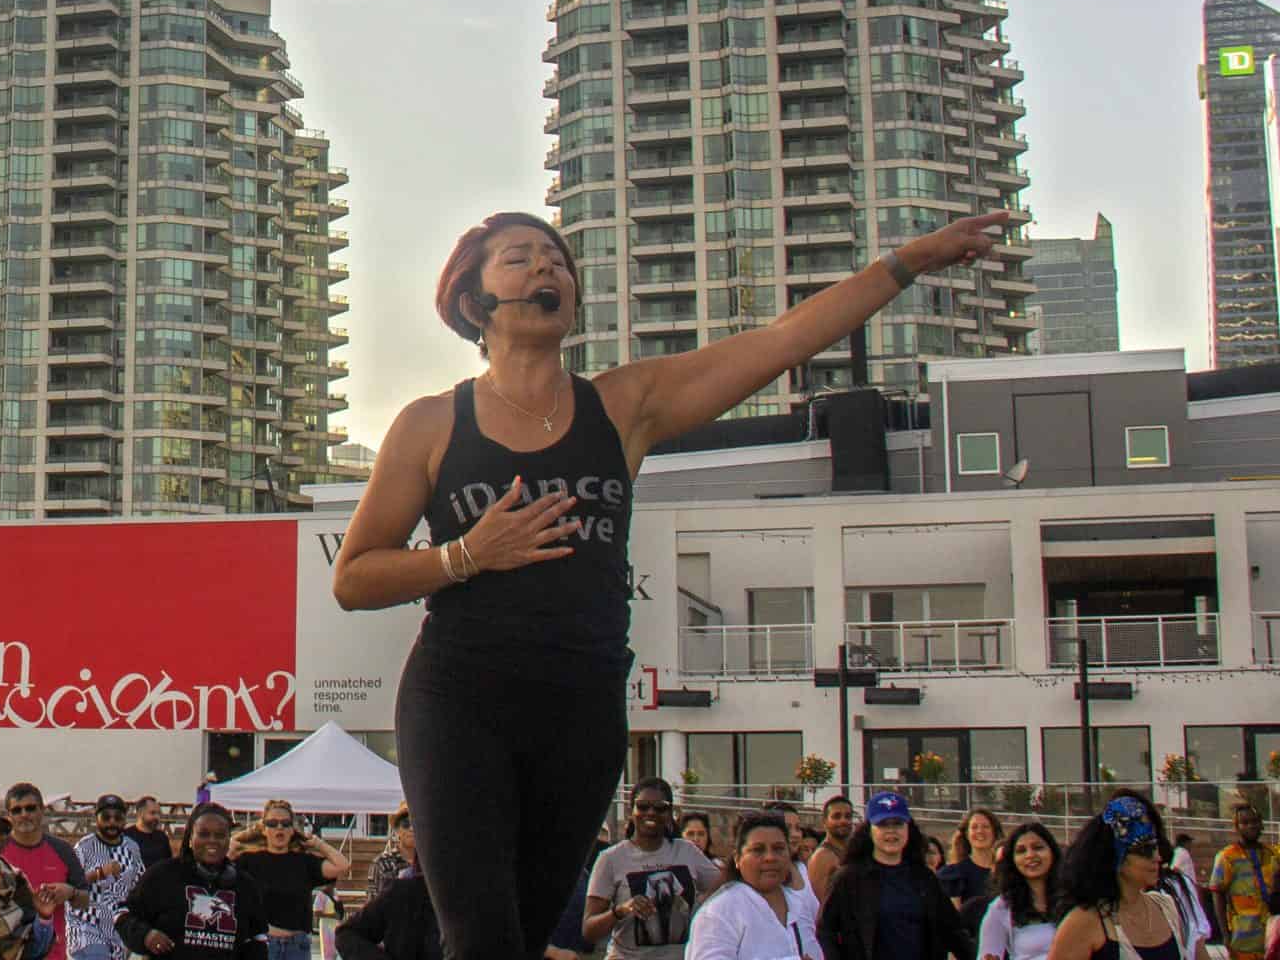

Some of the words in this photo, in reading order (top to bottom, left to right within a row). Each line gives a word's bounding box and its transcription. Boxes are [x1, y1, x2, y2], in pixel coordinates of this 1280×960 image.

[314, 676, 382, 689] unmatched
[314, 691, 368, 704] response
[314, 703, 343, 713] time.
